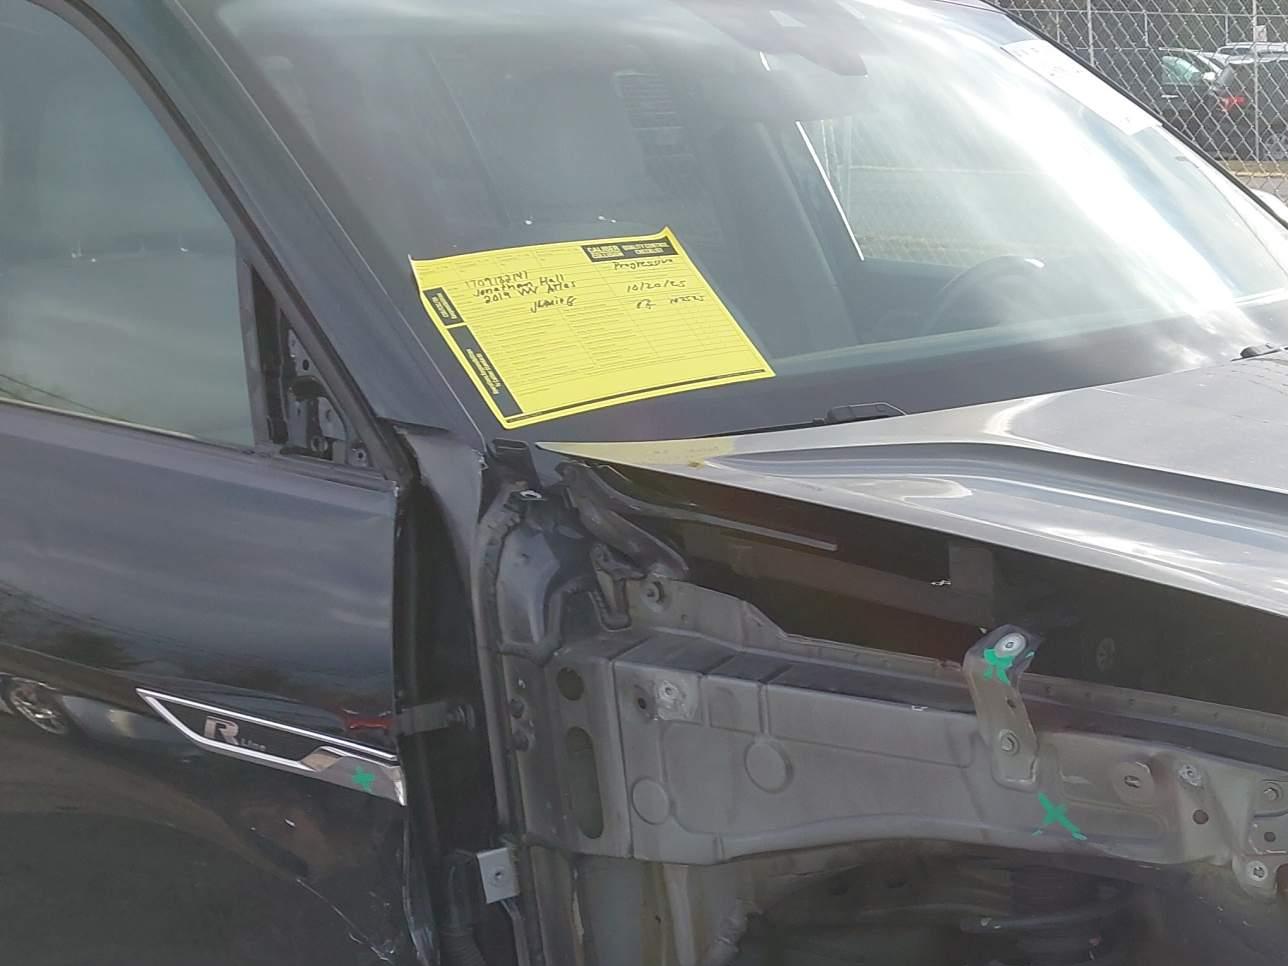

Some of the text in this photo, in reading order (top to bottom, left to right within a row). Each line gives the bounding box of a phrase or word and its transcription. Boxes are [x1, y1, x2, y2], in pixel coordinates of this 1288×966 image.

[483, 280, 577, 305] 2019 VW Atlas
[538, 273, 565, 287] Hall
[203, 715, 240, 746] R
